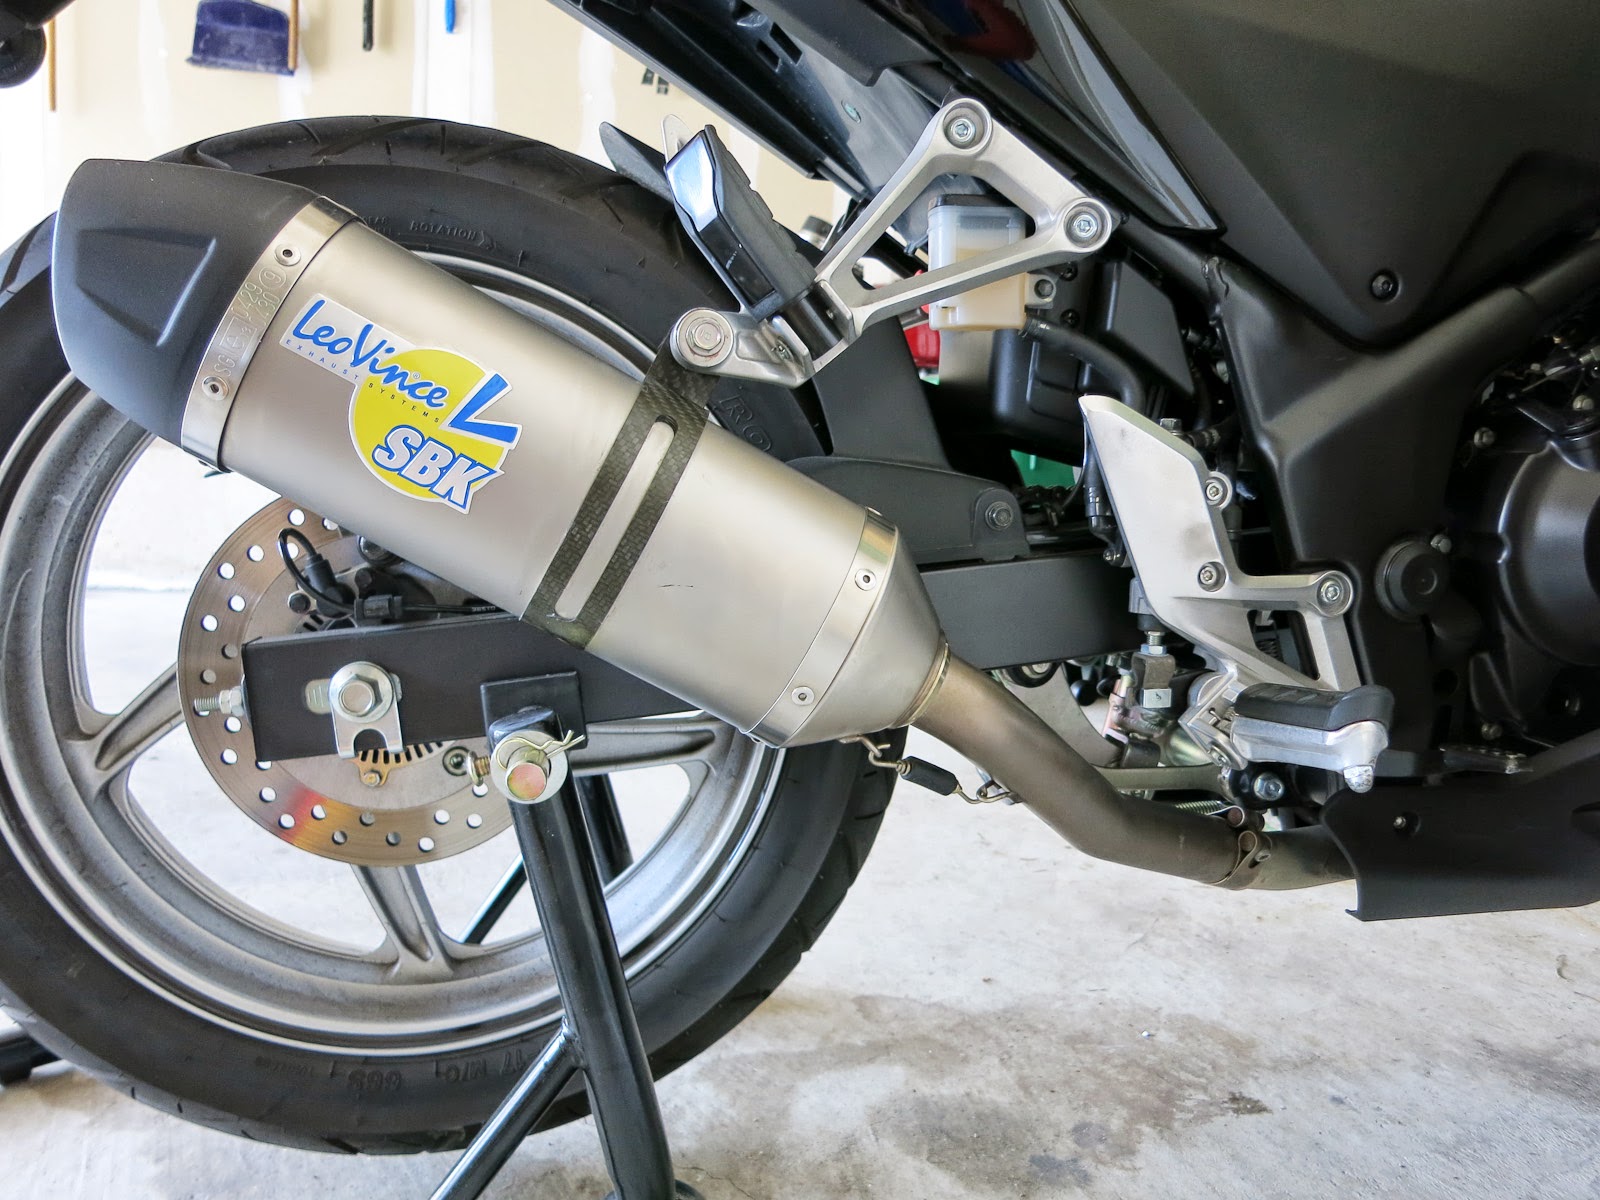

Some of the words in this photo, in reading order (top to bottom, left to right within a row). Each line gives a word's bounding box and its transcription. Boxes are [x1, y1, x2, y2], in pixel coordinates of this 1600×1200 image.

[409, 220, 478, 241] ROTATION
[285, 338, 360, 381] EXHAUST
[368, 381, 441, 423] SYSTEMS
[292, 299, 449, 408] LeoVince
[372, 424, 498, 509] SBK
